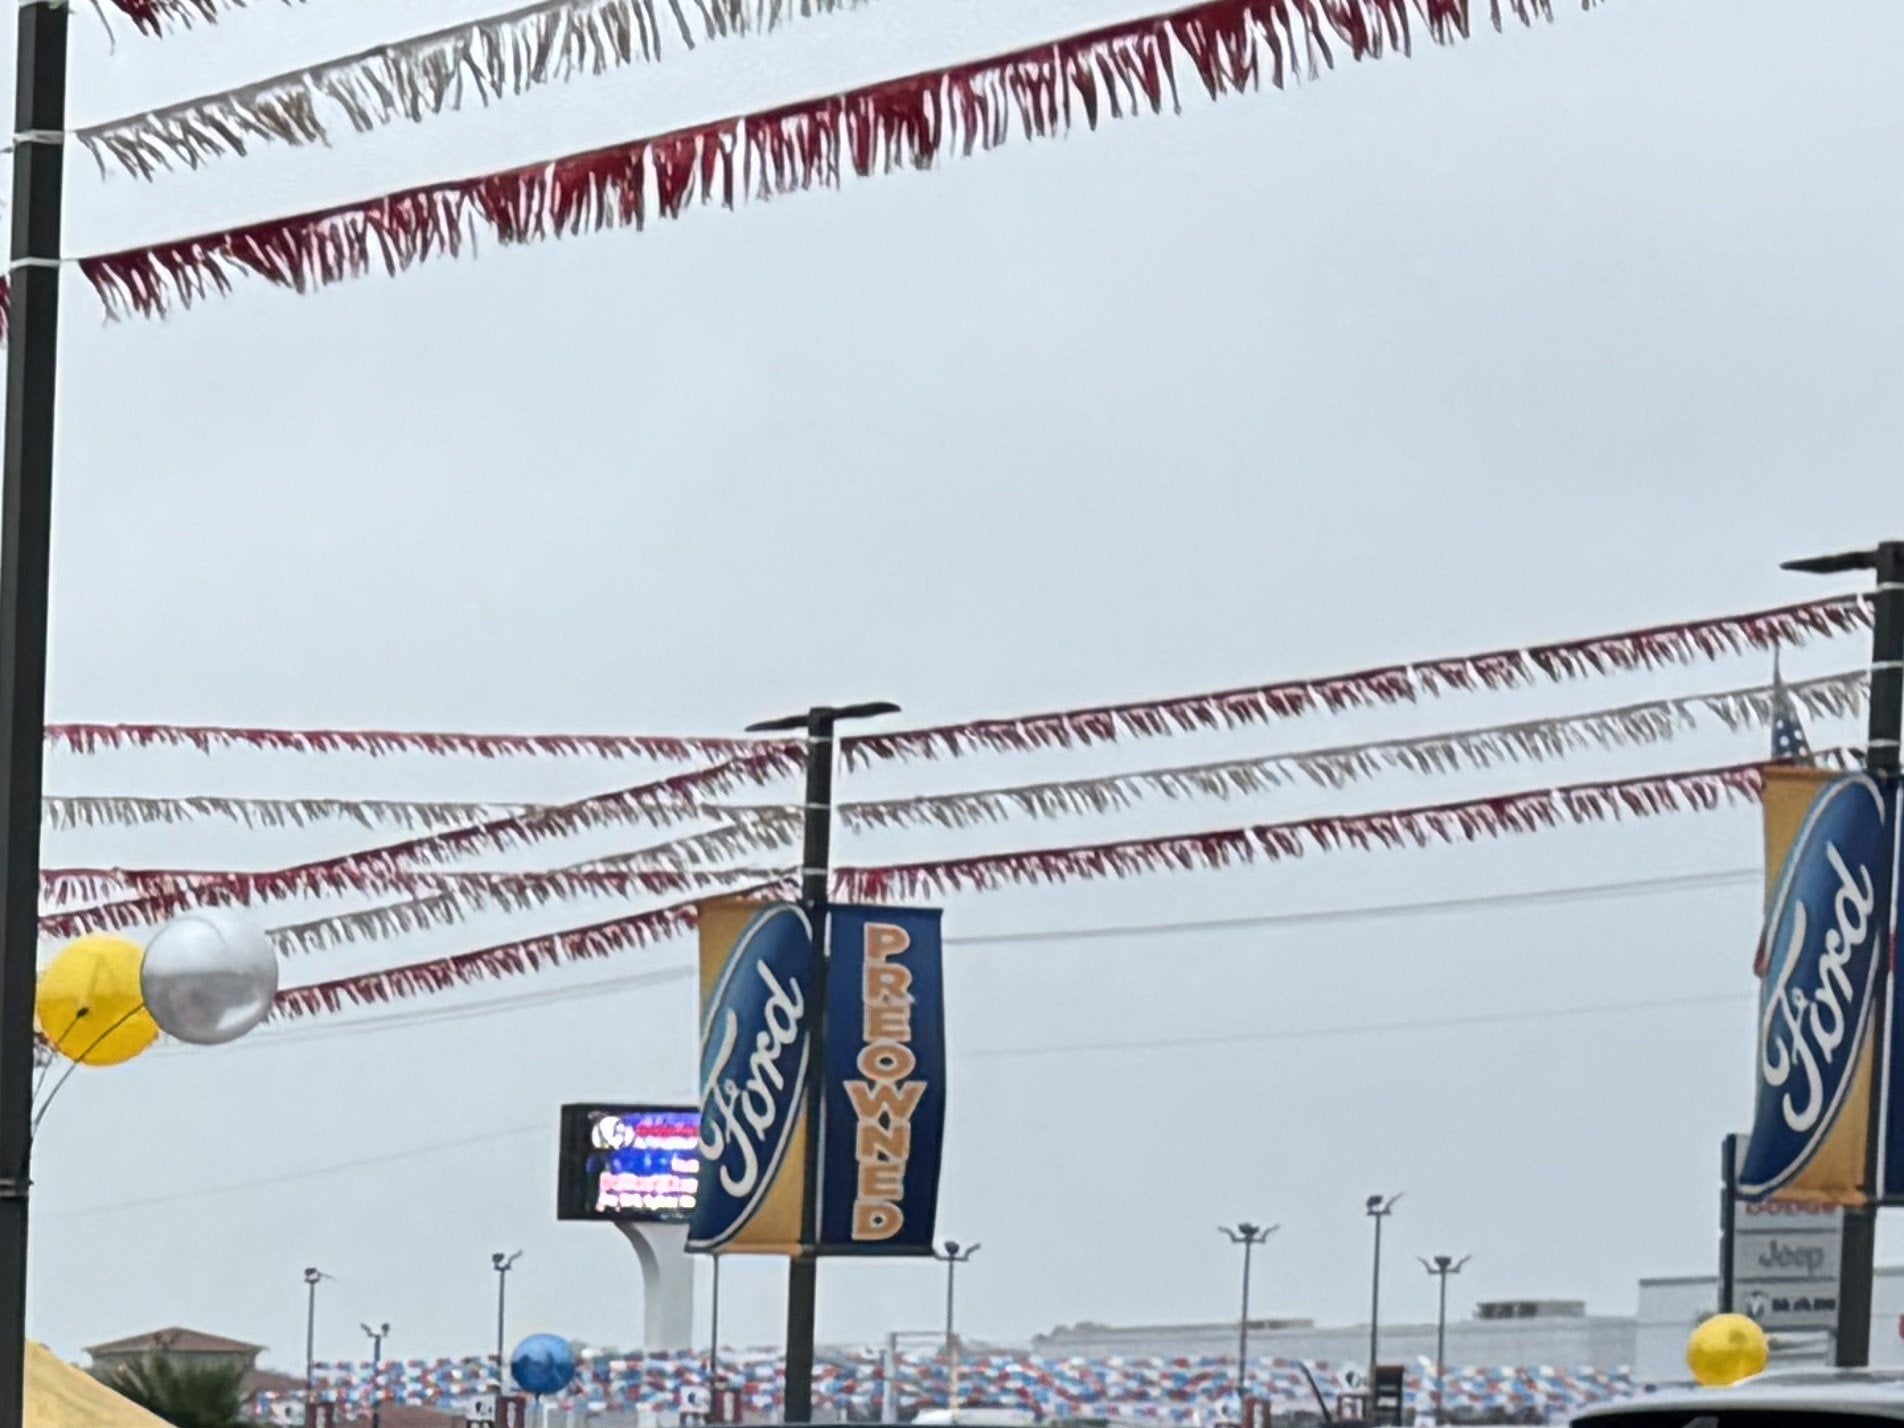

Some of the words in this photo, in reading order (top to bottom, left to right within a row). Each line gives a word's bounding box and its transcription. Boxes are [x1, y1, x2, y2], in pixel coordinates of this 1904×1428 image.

[696, 957, 805, 1199] Ford
[843, 921, 928, 1241] PREOWNED
[1761, 839, 1874, 1133] Ford
[1758, 1240, 1825, 1277] Jeep
